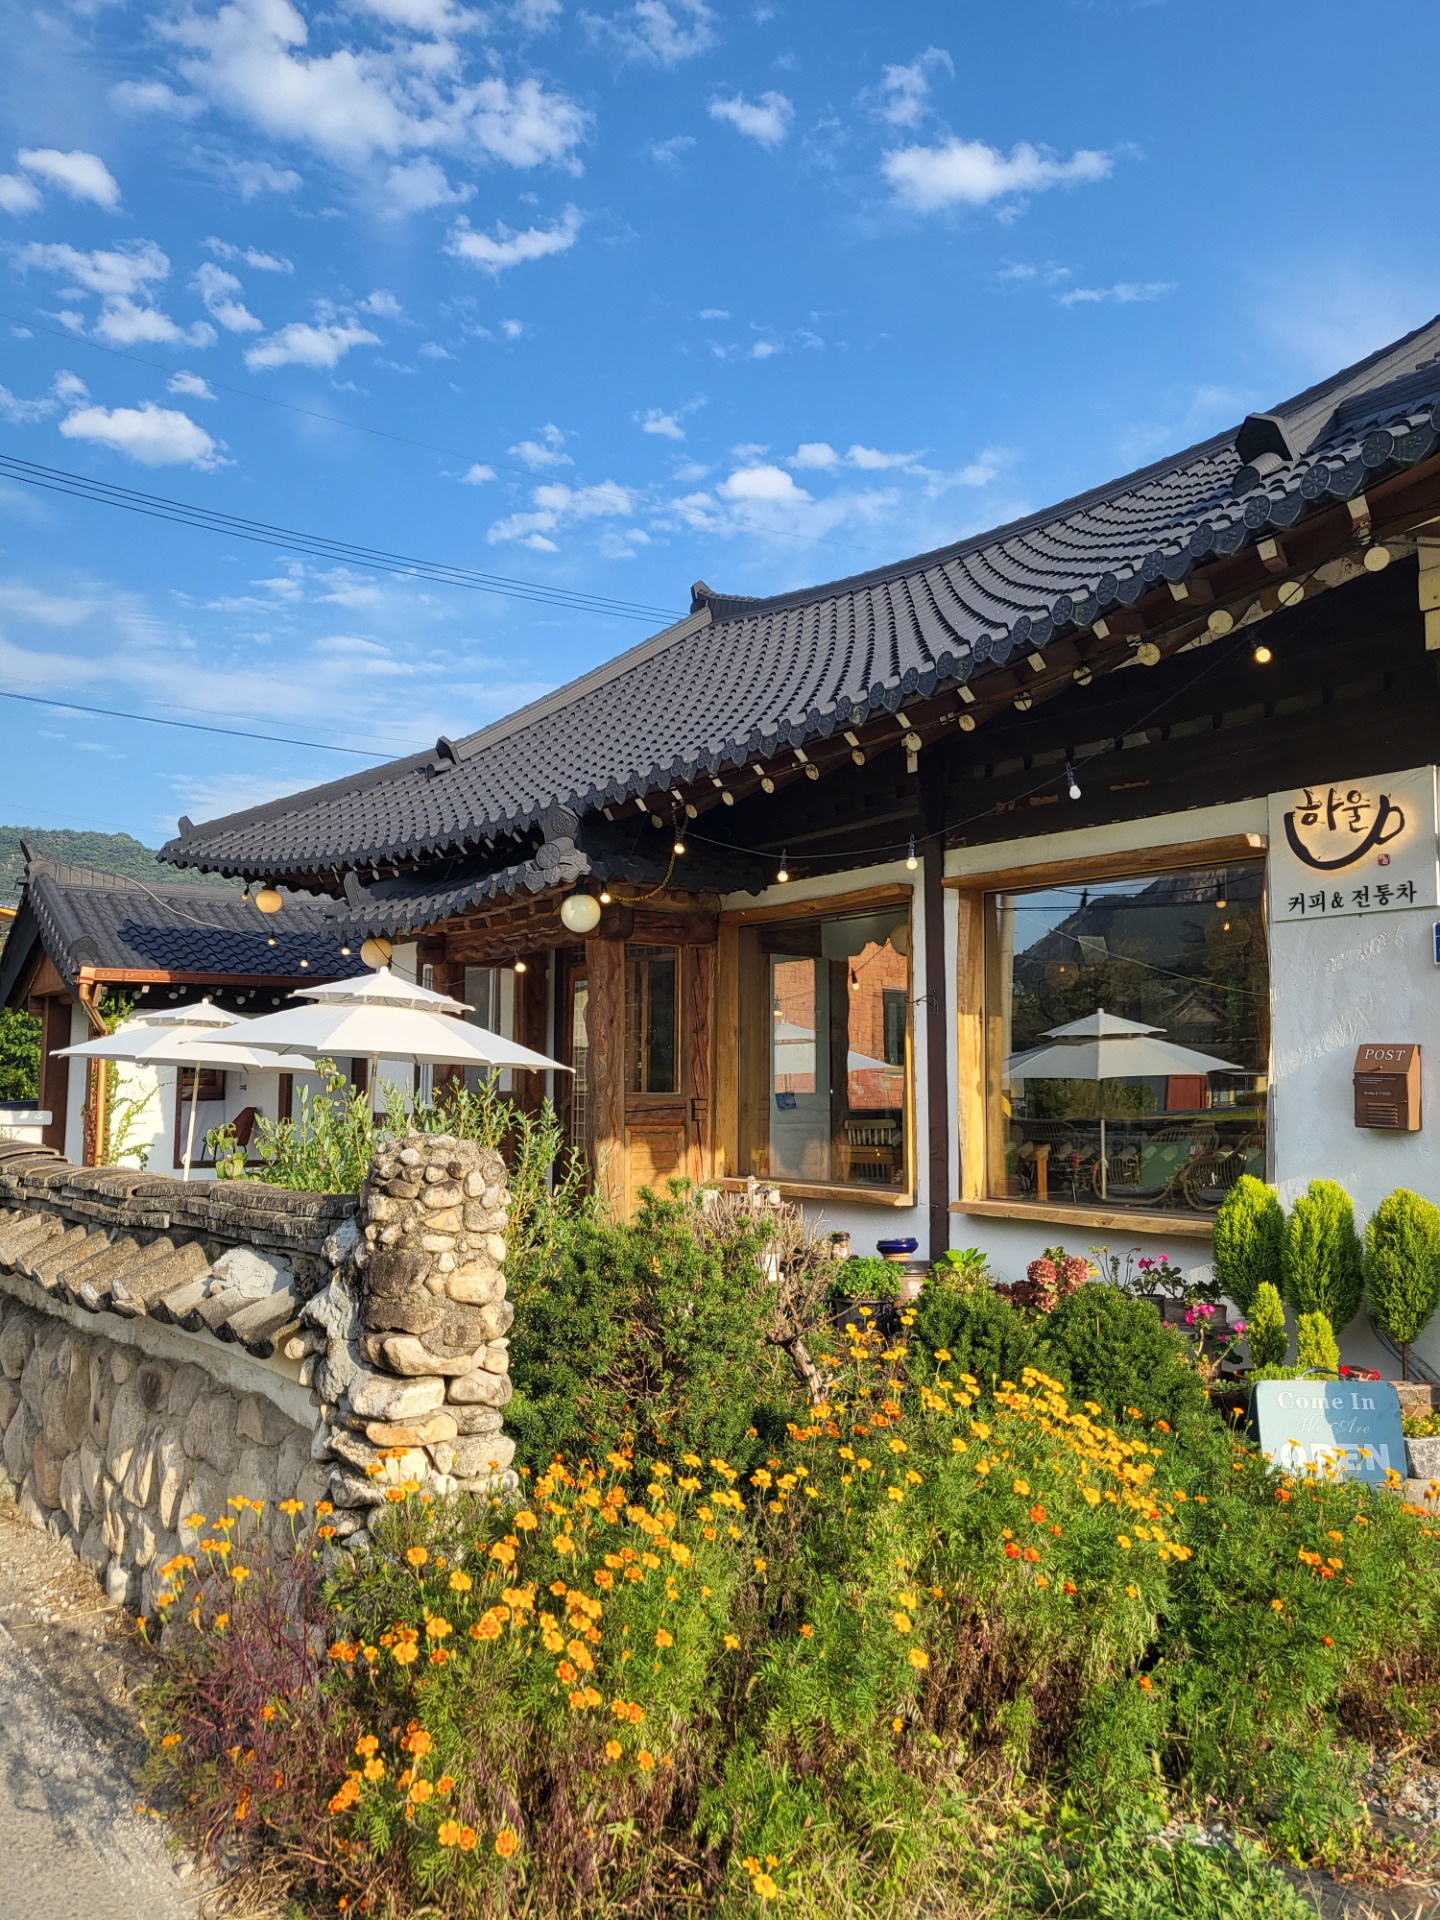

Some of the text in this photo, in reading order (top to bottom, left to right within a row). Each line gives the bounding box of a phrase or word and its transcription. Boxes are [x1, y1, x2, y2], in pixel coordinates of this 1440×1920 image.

[1295, 788, 1371, 833] 하울
[1351, 880, 1417, 908] 전통차
[1363, 1048, 1406, 1061] POST
[1277, 1391, 1376, 1410] Come In
[1294, 1415, 1370, 1434] We Are
